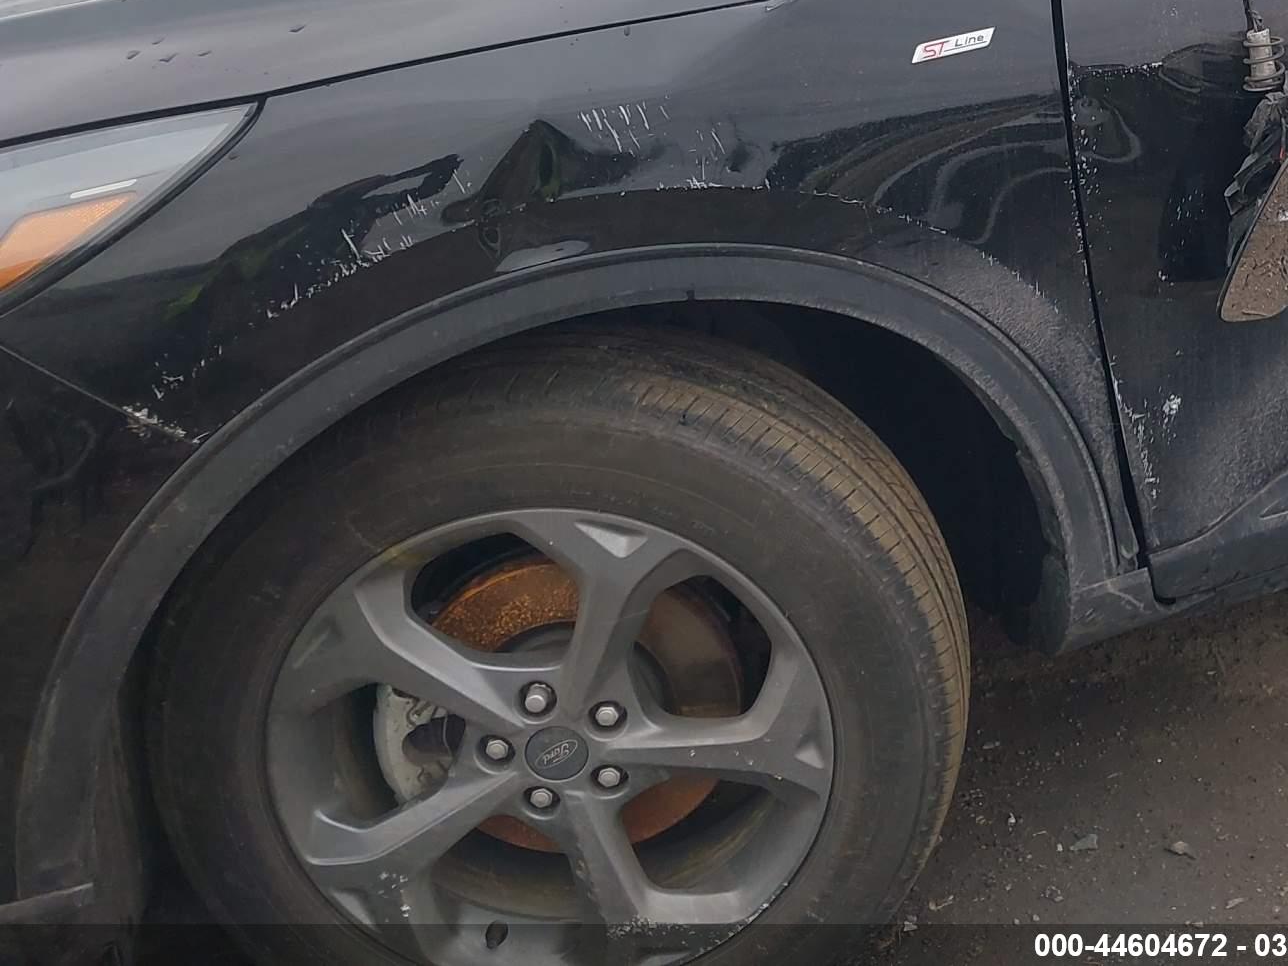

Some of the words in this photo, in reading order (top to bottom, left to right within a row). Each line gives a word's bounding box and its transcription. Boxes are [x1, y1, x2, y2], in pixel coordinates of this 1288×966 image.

[920, 40, 950, 59] ST
[954, 35, 985, 48] Line
[542, 743, 570, 766] Ford
